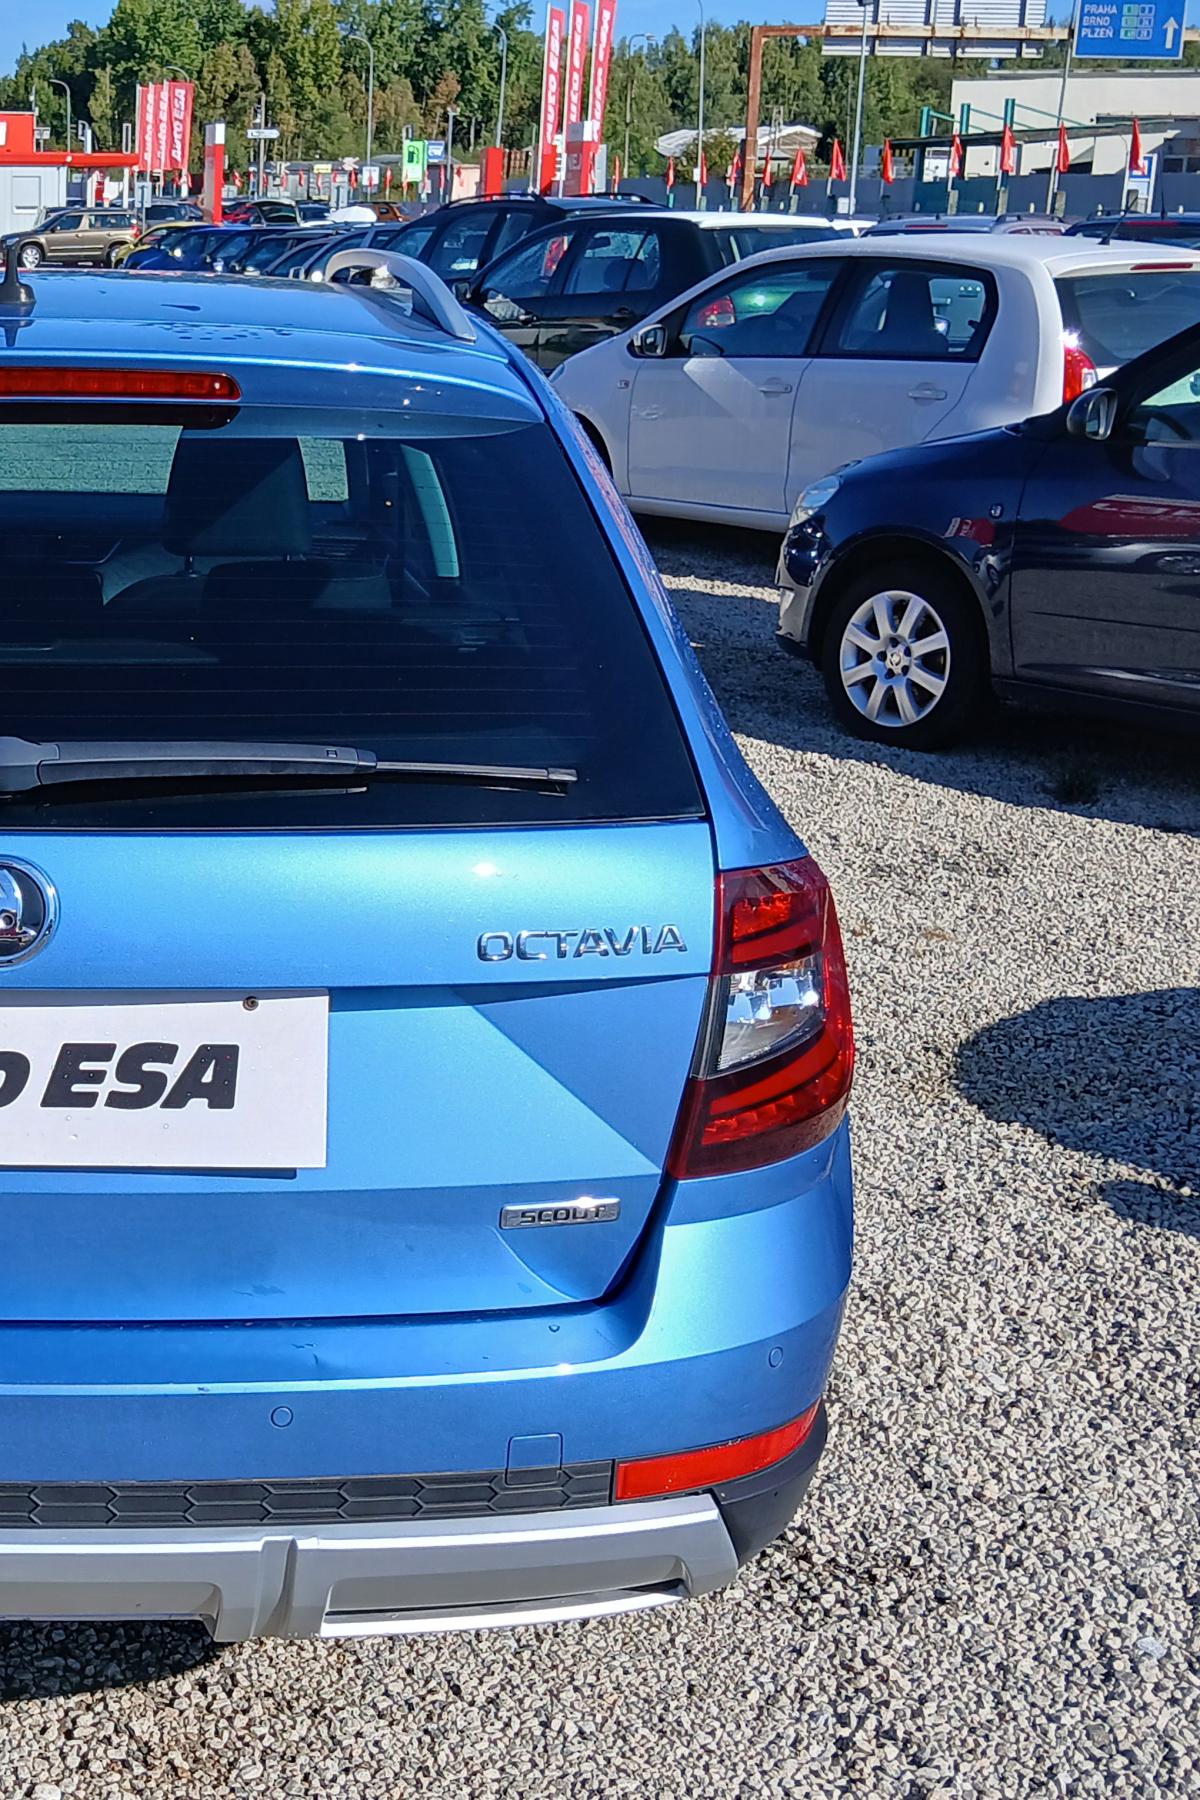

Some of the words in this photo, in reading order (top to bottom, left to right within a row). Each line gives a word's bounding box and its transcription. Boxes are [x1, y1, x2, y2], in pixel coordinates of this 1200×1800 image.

[1084, 4, 1117, 14] PRAHA
[1083, 16, 1110, 26] BRNO
[477, 924, 688, 962] OCTAVIA
[39, 1042, 240, 1110] ESA
[520, 1205, 607, 1224] SCOUT
